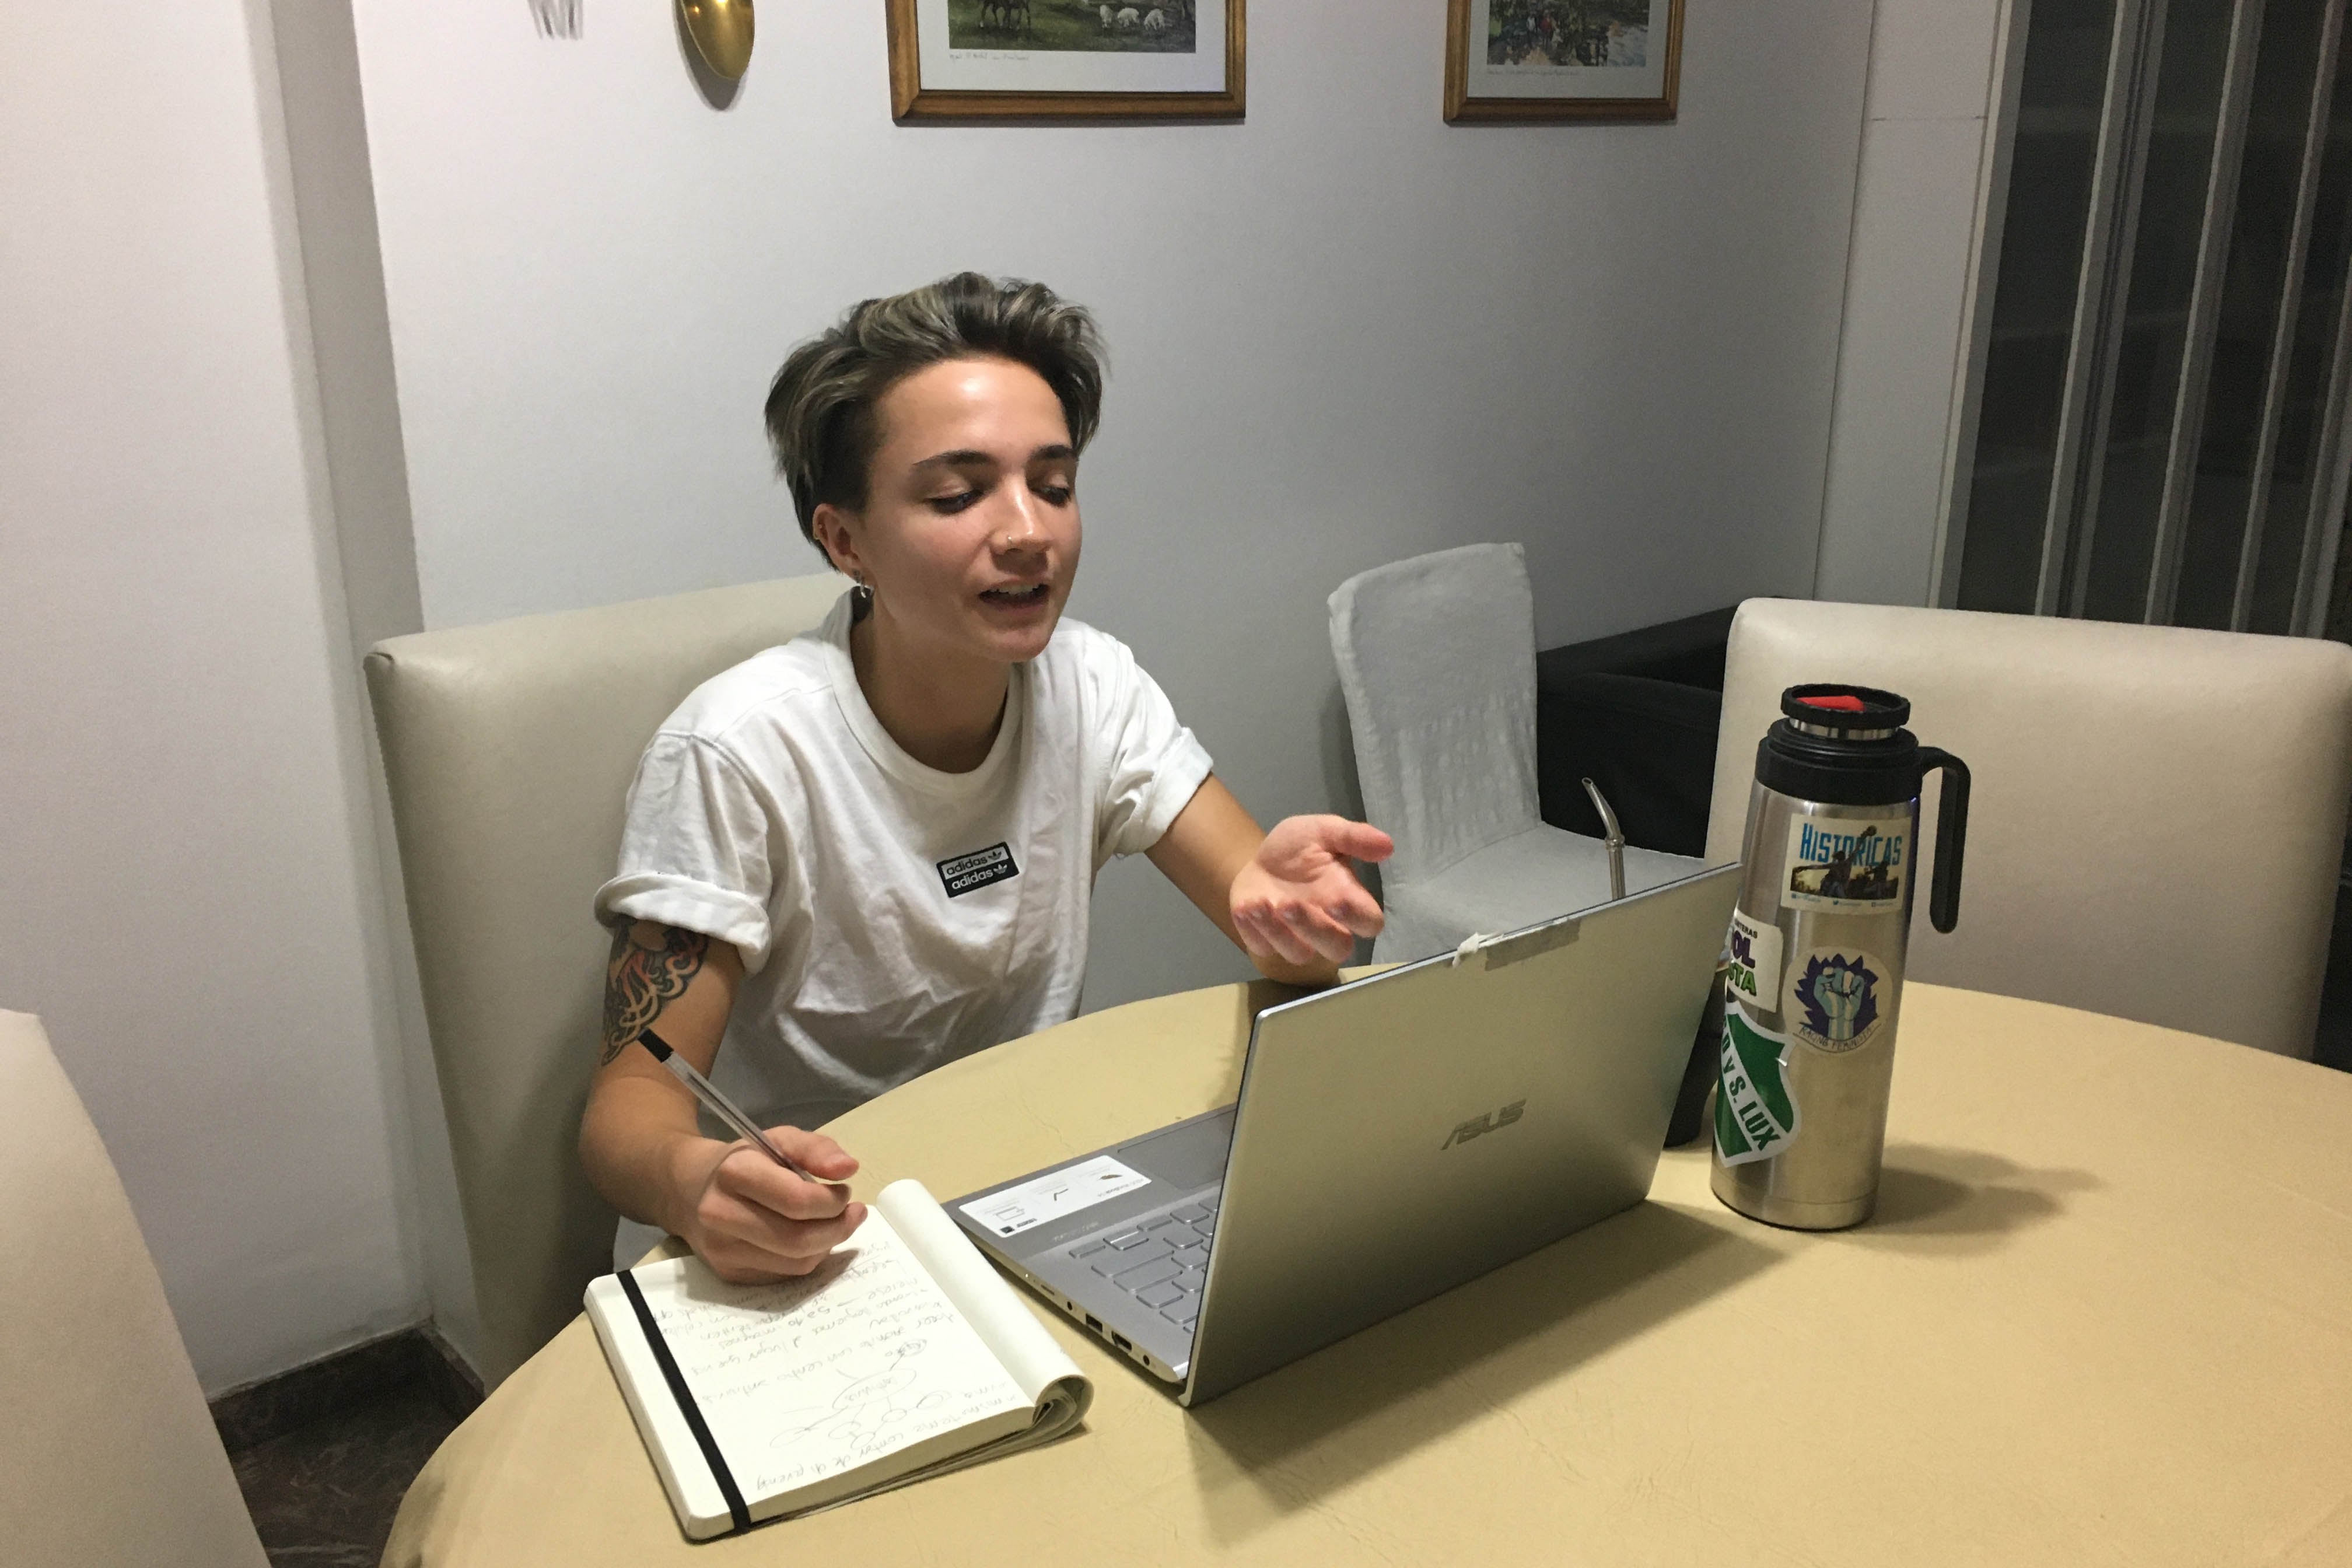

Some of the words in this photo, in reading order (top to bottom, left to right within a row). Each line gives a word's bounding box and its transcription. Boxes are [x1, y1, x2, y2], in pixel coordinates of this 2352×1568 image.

[947, 857, 988, 875] adidas
[951, 869, 993, 889] adidas
[1440, 1098, 1527, 1150] ASUS
[1738, 1101, 1781, 1151] LUX
